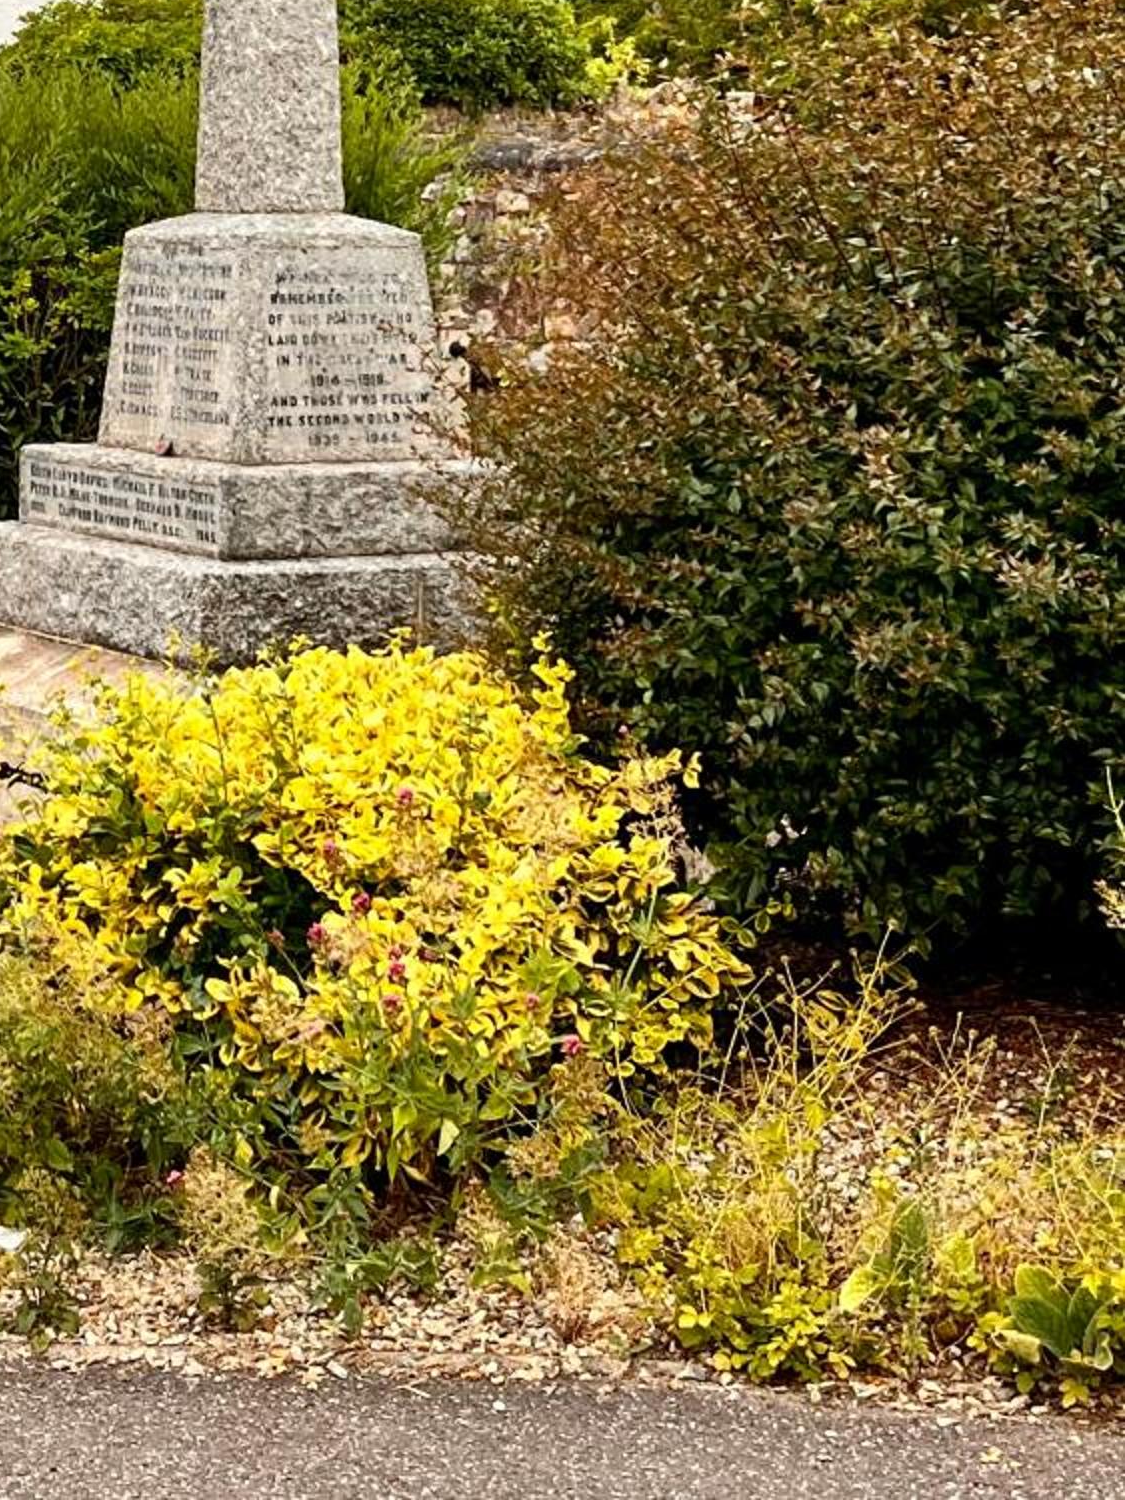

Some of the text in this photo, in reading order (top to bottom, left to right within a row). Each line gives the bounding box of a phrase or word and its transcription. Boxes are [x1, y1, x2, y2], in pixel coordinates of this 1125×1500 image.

[268, 313, 284, 325] OF
[268, 333, 298, 346] LAID
[277, 354, 290, 366] IN
[270, 395, 298, 407] AND
[303, 394, 343, 407] THOSE
[382, 393, 413, 405] FELL
[266, 415, 292, 427] THE
[298, 414, 350, 427] SECOND
[354, 412, 400, 425] WORLD
